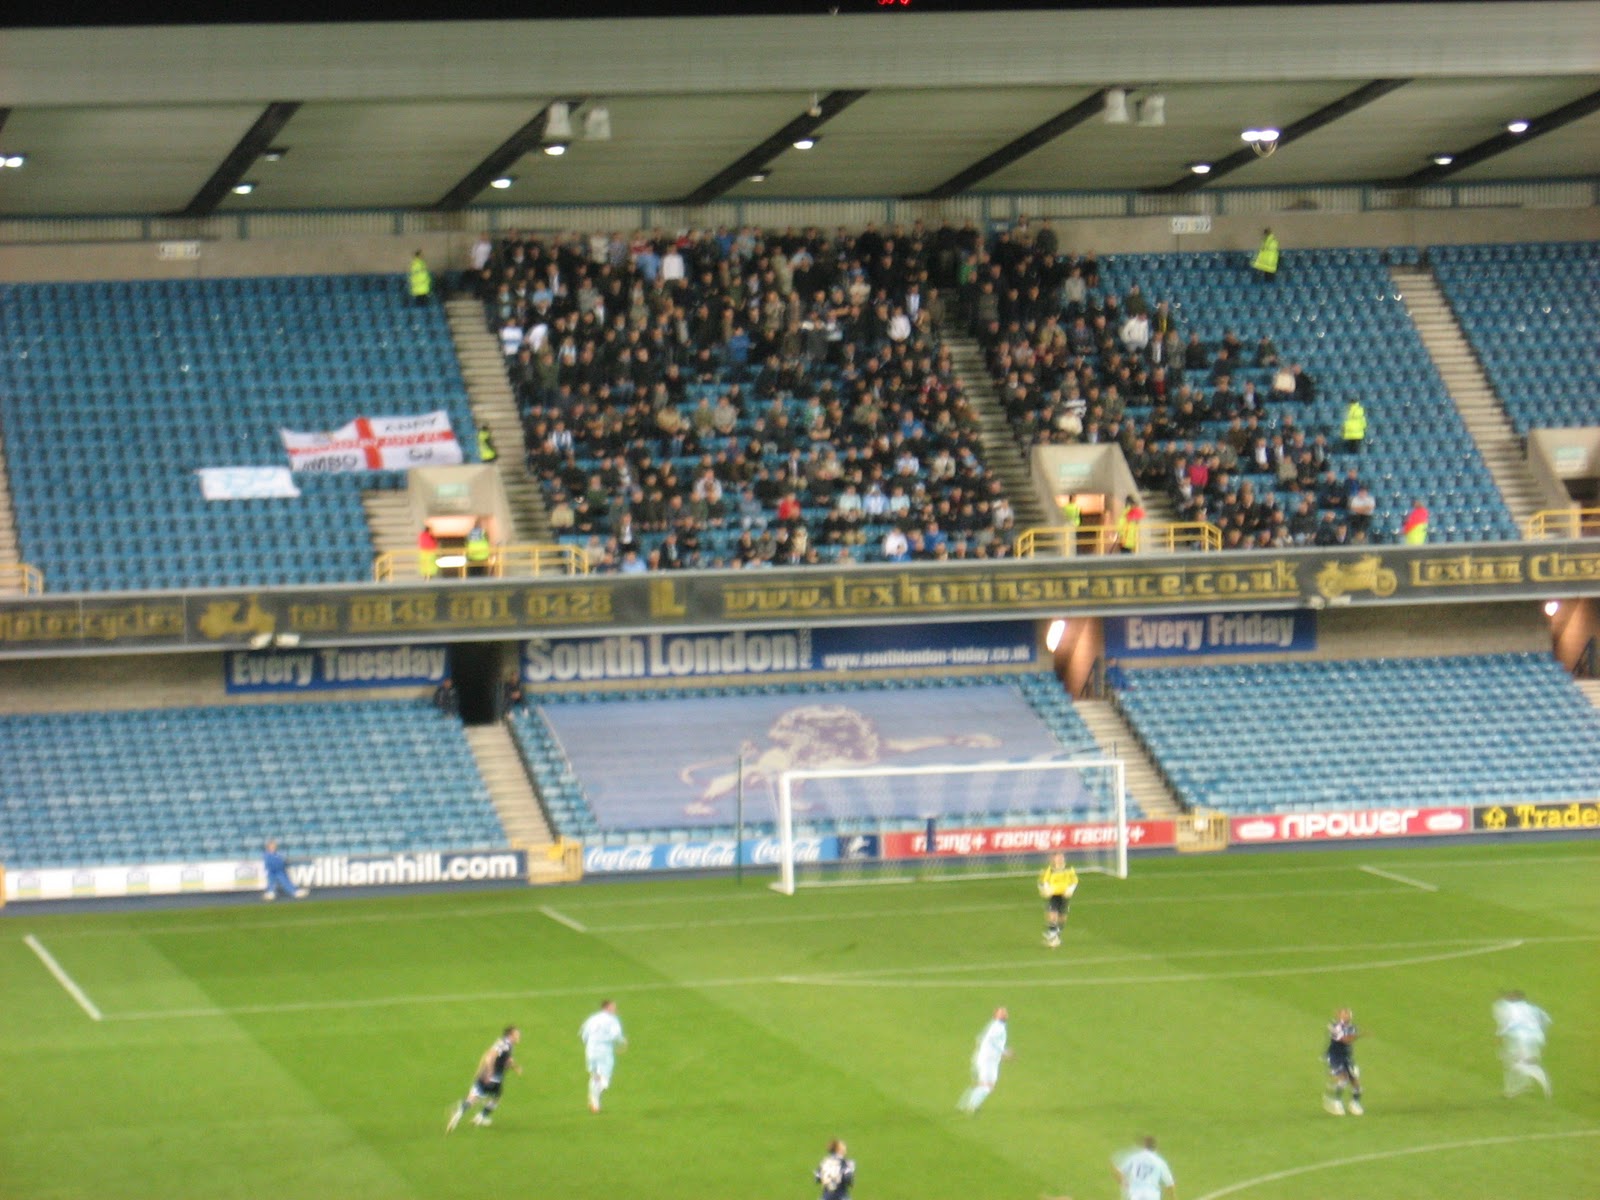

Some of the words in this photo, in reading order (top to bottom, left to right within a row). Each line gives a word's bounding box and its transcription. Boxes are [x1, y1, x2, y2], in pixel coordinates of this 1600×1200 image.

[722, 560, 1299, 618] www.lexhaminsurance.co.uk
[1410, 556, 1523, 586] Lexham
[1125, 618, 1204, 650] Every
[1209, 614, 1295, 647] Friday
[231, 651, 314, 686] Every
[322, 647, 447, 681] Tuesday
[525, 634, 645, 681] South
[1281, 809, 1420, 839] npower
[290, 853, 518, 887] williamhill.com
